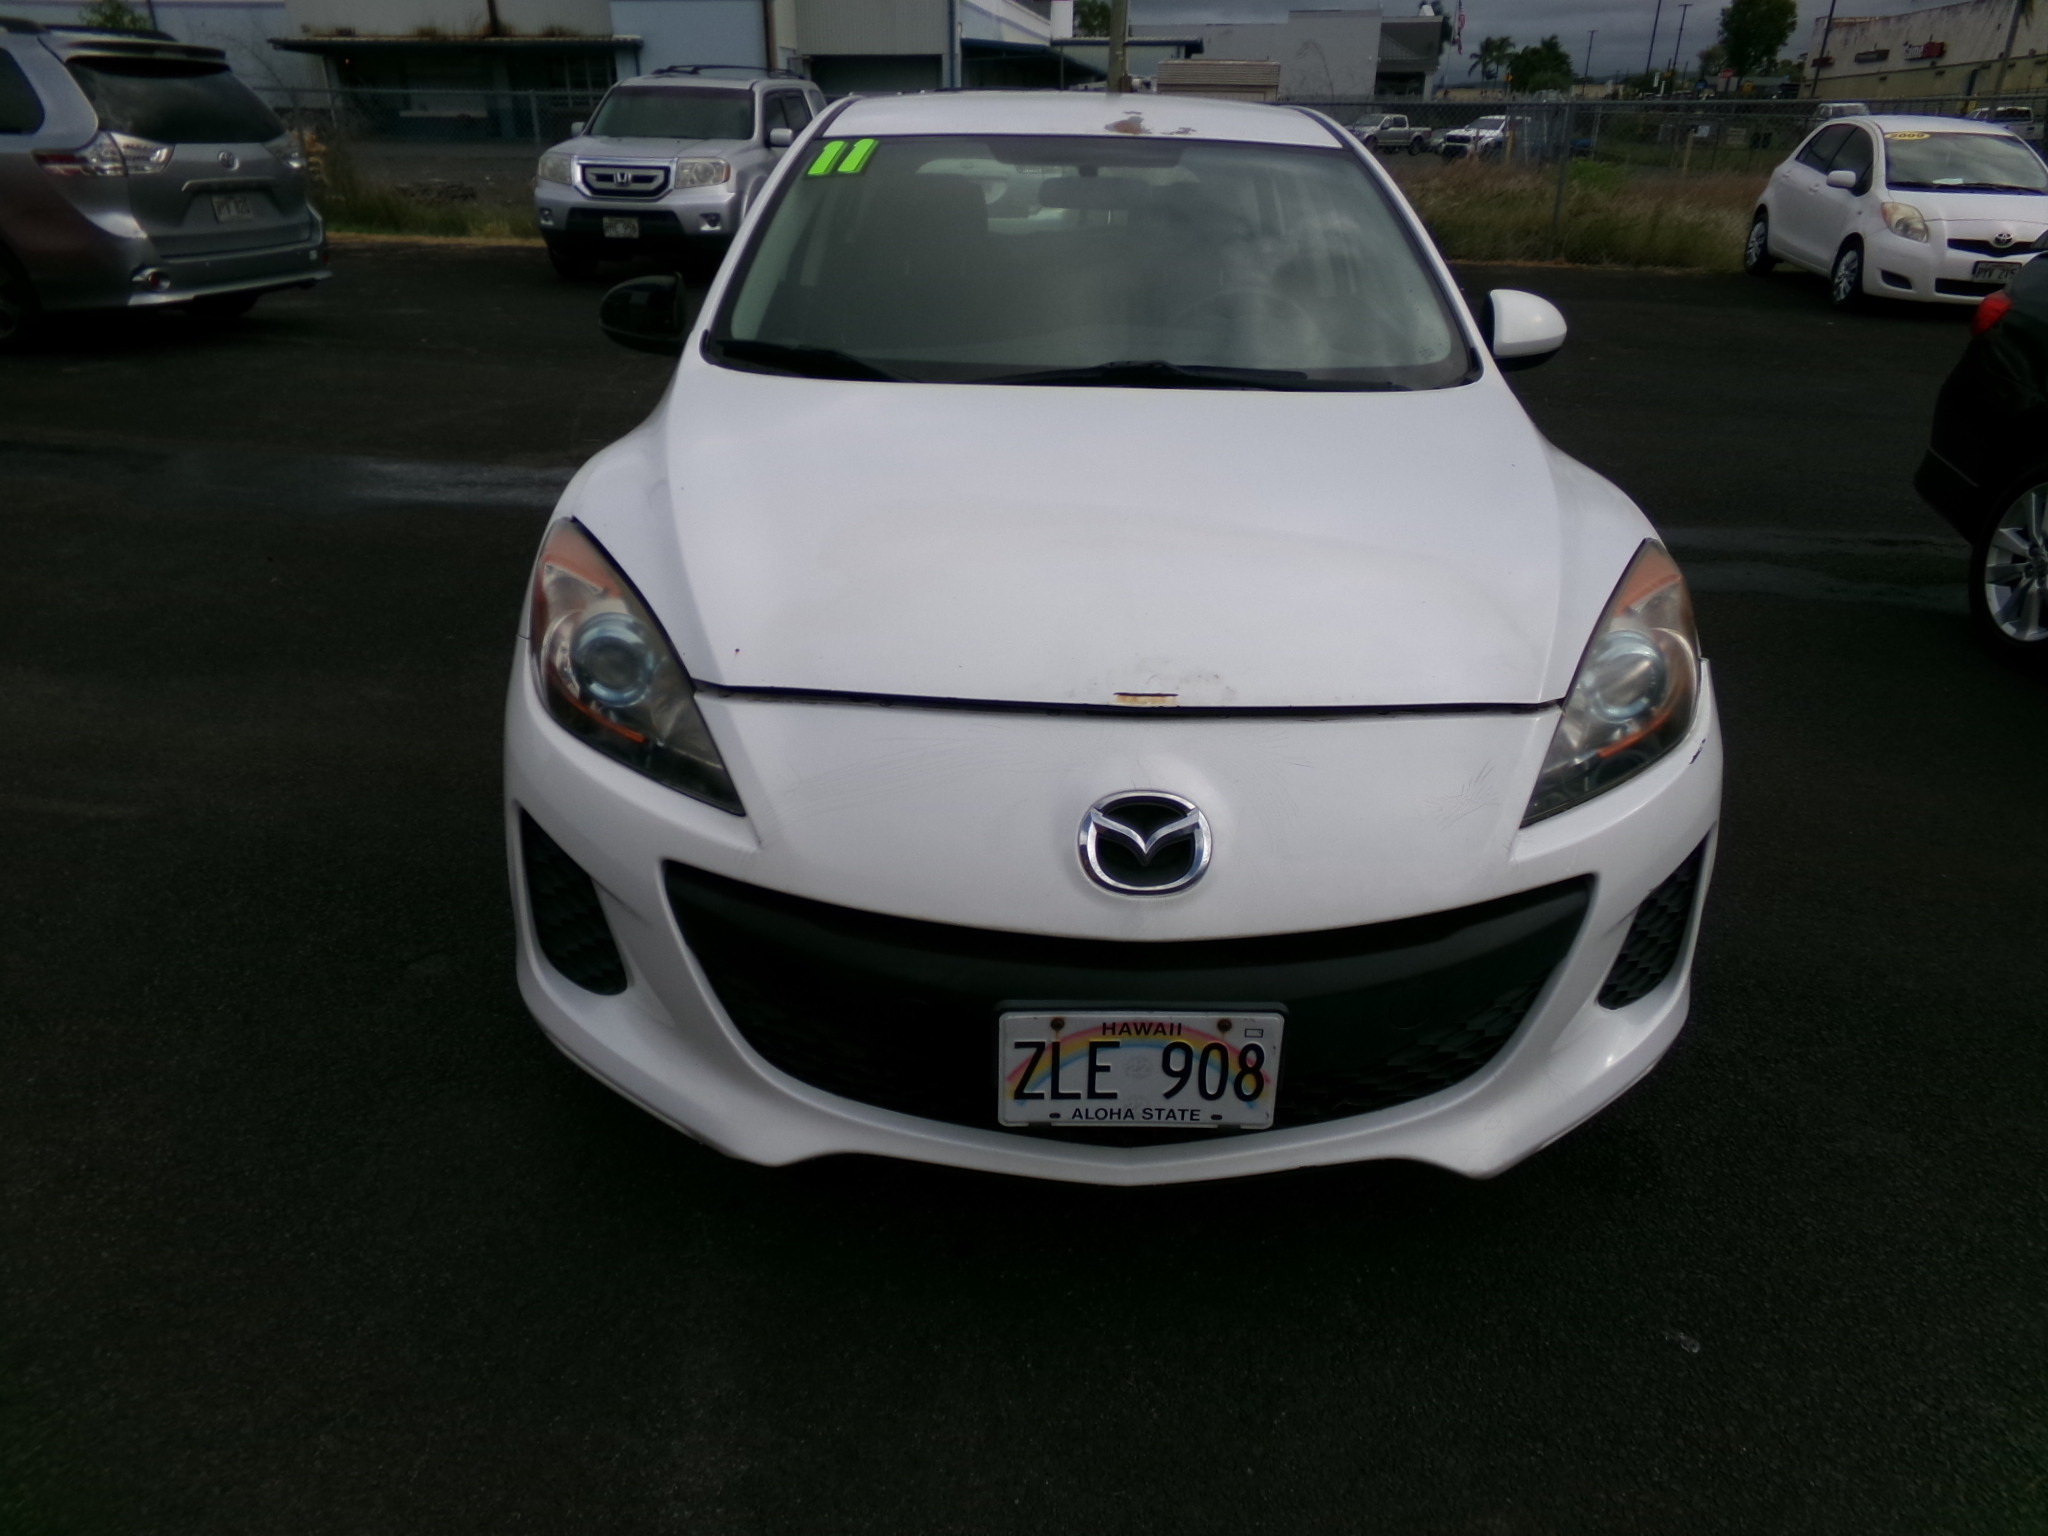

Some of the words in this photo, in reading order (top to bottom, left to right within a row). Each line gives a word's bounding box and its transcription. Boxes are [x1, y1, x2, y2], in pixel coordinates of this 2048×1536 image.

[807, 138, 878, 175] 11
[1102, 1022, 1182, 1036] HAWAII
[1014, 1041, 1120, 1100] ZLE
[1162, 1041, 1265, 1102] 908
[1071, 1107, 1134, 1121] ALOHA
[1142, 1107, 1202, 1121] STATE
